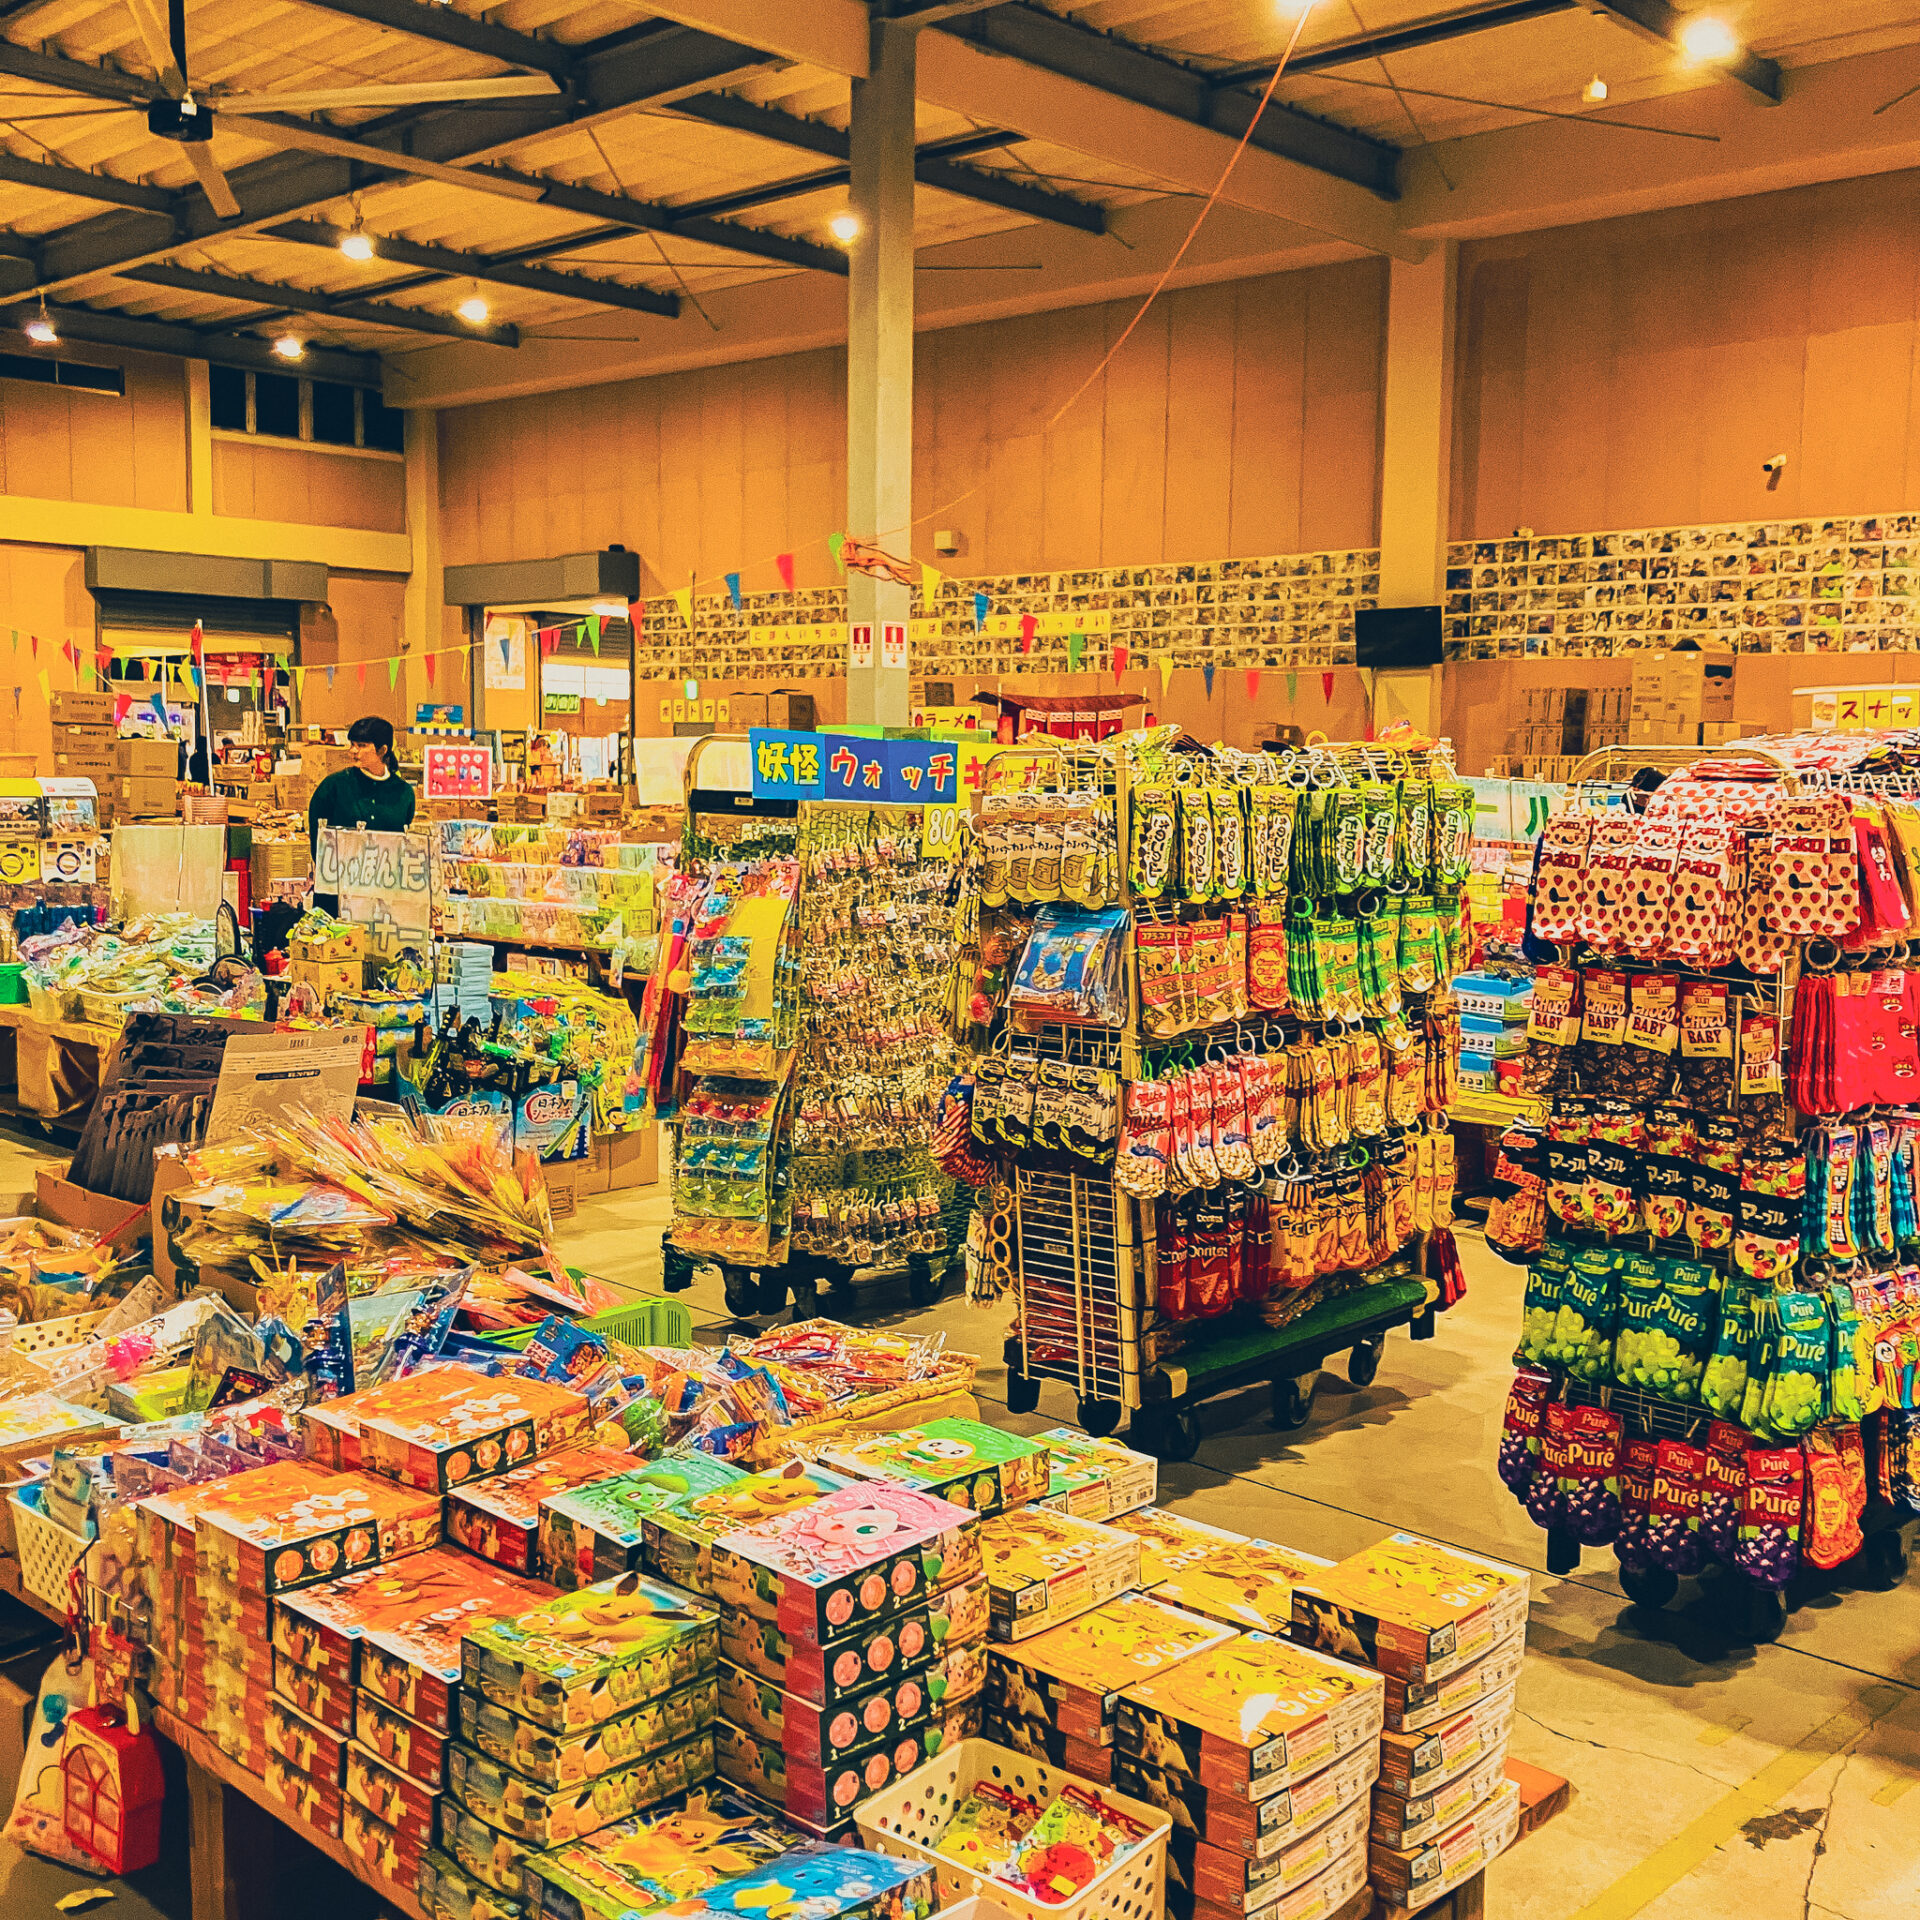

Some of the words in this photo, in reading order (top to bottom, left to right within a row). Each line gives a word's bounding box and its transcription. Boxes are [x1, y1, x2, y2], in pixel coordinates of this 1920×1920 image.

[1534, 1012, 1563, 1031] BABY
[1588, 1014, 1619, 1031] BABY
[1632, 1016, 1667, 1037] BABY
[1687, 1030, 1722, 1044] BABY
[1630, 1260, 1656, 1275] Puré
[1674, 1266, 1701, 1283] Puré
[1563, 1269, 1598, 1307] Puré
[1655, 1292, 1698, 1332] Puré
[1779, 1335, 1826, 1361] Puré
[1505, 1395, 1540, 1428] Puré
[1568, 1443, 1616, 1468] Puré
[1667, 1450, 1695, 1469] Puré
[1761, 1456, 1791, 1473] Puré
[1706, 1456, 1746, 1488] Puré
[1653, 1478, 1700, 1509] Puré
[1750, 1487, 1801, 1516] Puré
[893, 1596, 901, 1609] 2
[827, 1625, 835, 1638] 1
[902, 1658, 909, 1670] 2
[834, 1687, 843, 1699] 1
[899, 1718, 906, 1731] 2
[831, 1749, 838, 1761] 1
